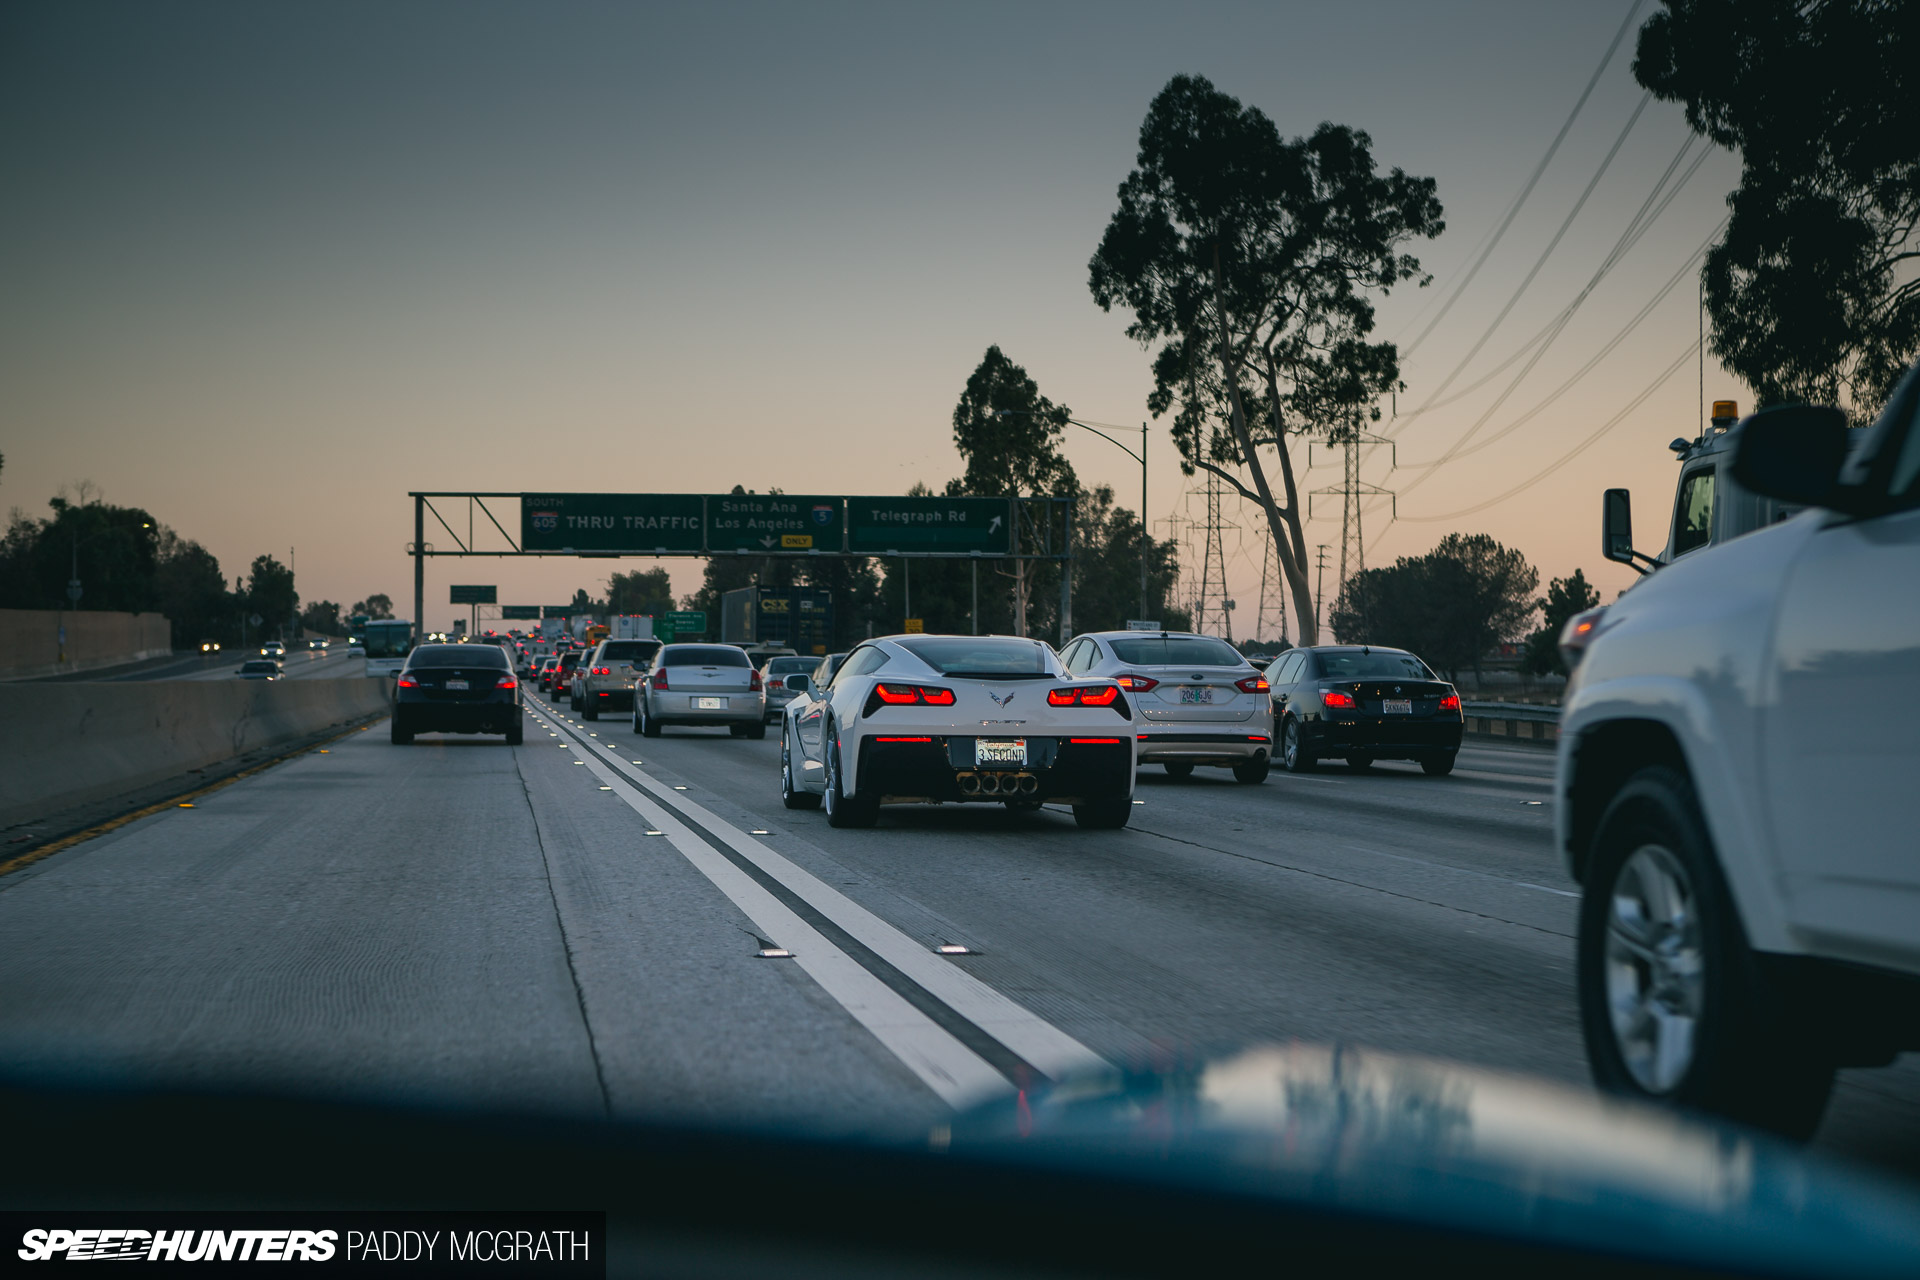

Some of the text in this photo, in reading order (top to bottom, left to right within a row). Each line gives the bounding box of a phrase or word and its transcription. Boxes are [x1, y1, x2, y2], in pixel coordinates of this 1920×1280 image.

[526, 497, 564, 507] SOUTH
[722, 501, 798, 513] Santa Ana
[533, 517, 557, 529] 605
[566, 516, 699, 530] THRU TRAFFIC
[818, 512, 828, 523] 5
[871, 510, 967, 524] Telegraph Rd
[715, 518, 804, 532] Los Angeles
[785, 535, 808, 545] ONLY
[761, 599, 790, 611] CSX
[1181, 690, 1212, 700] 206 GJG
[978, 748, 1025, 762] 3 SECOND
